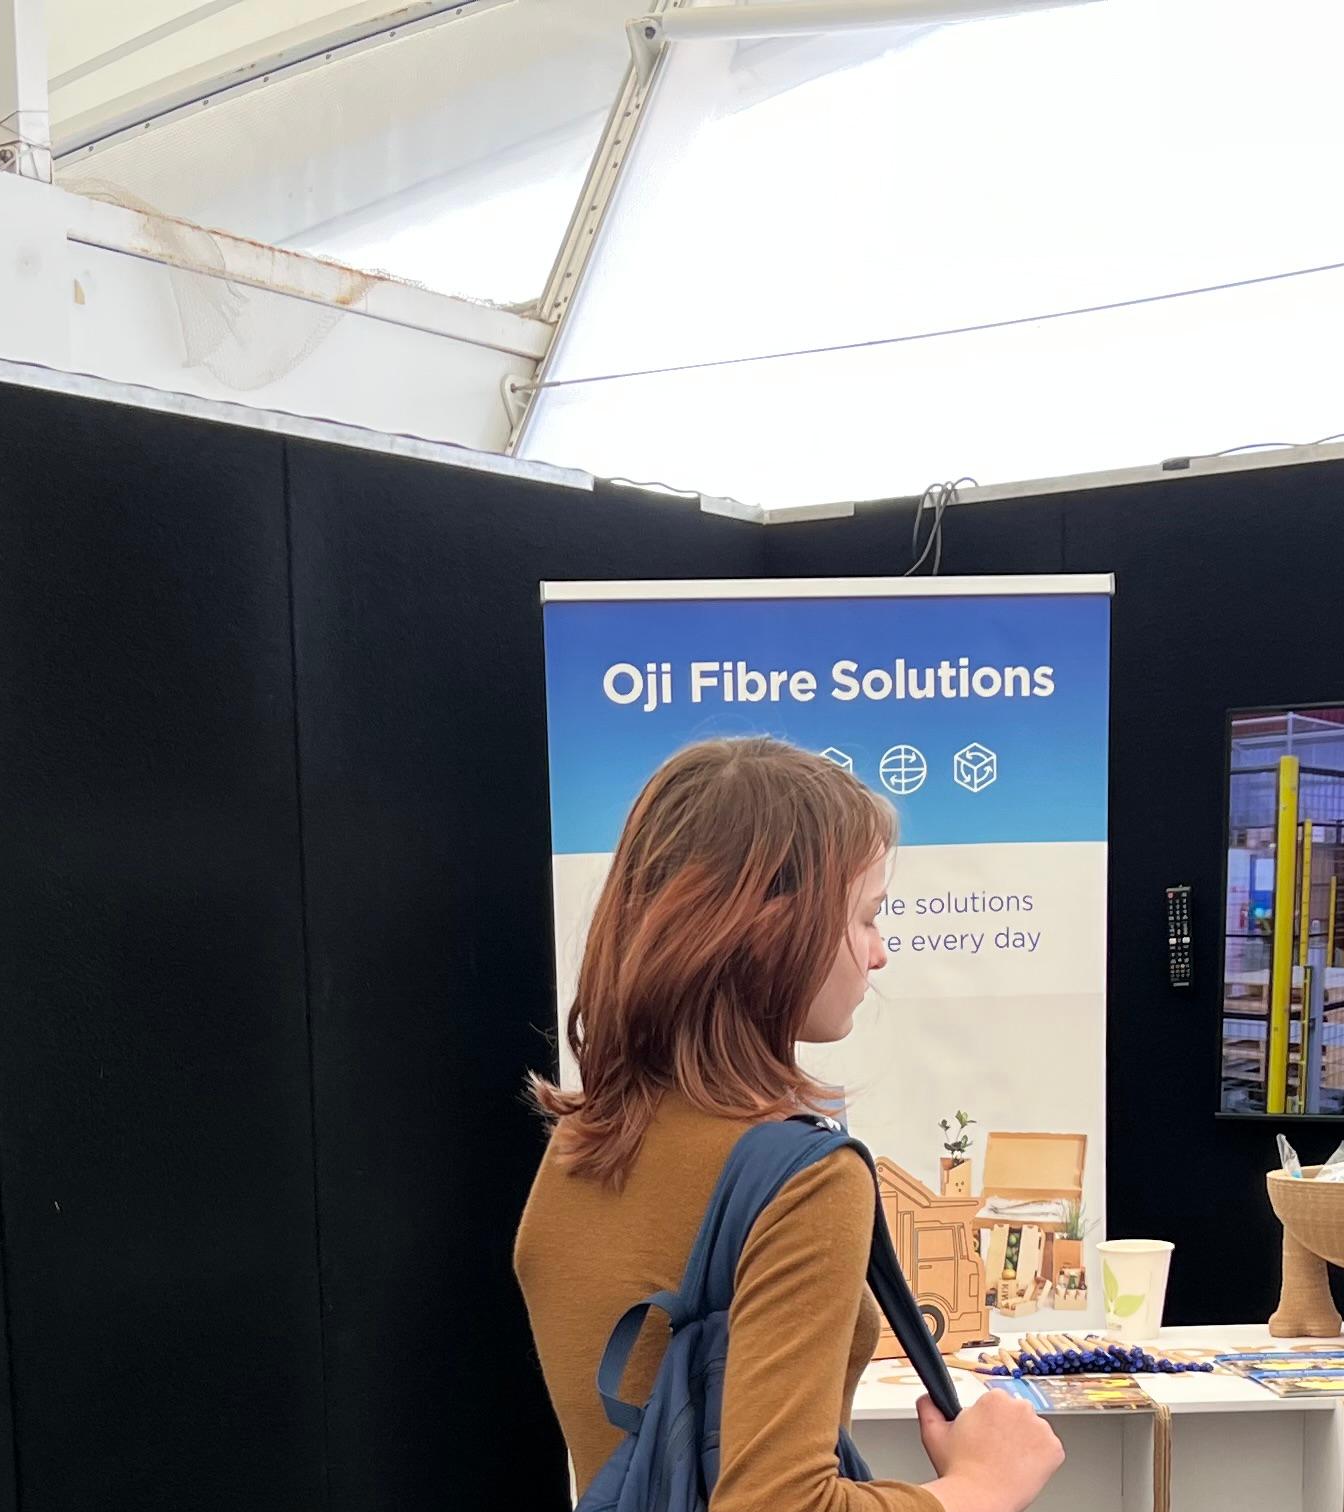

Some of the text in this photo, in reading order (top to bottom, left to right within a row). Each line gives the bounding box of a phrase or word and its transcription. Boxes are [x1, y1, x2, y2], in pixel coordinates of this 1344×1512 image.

[603, 657, 1056, 712] Oji Fibre Solutions
[915, 890, 1034, 915] solutions
[911, 932, 985, 954] every
[994, 926, 1041, 952] day
